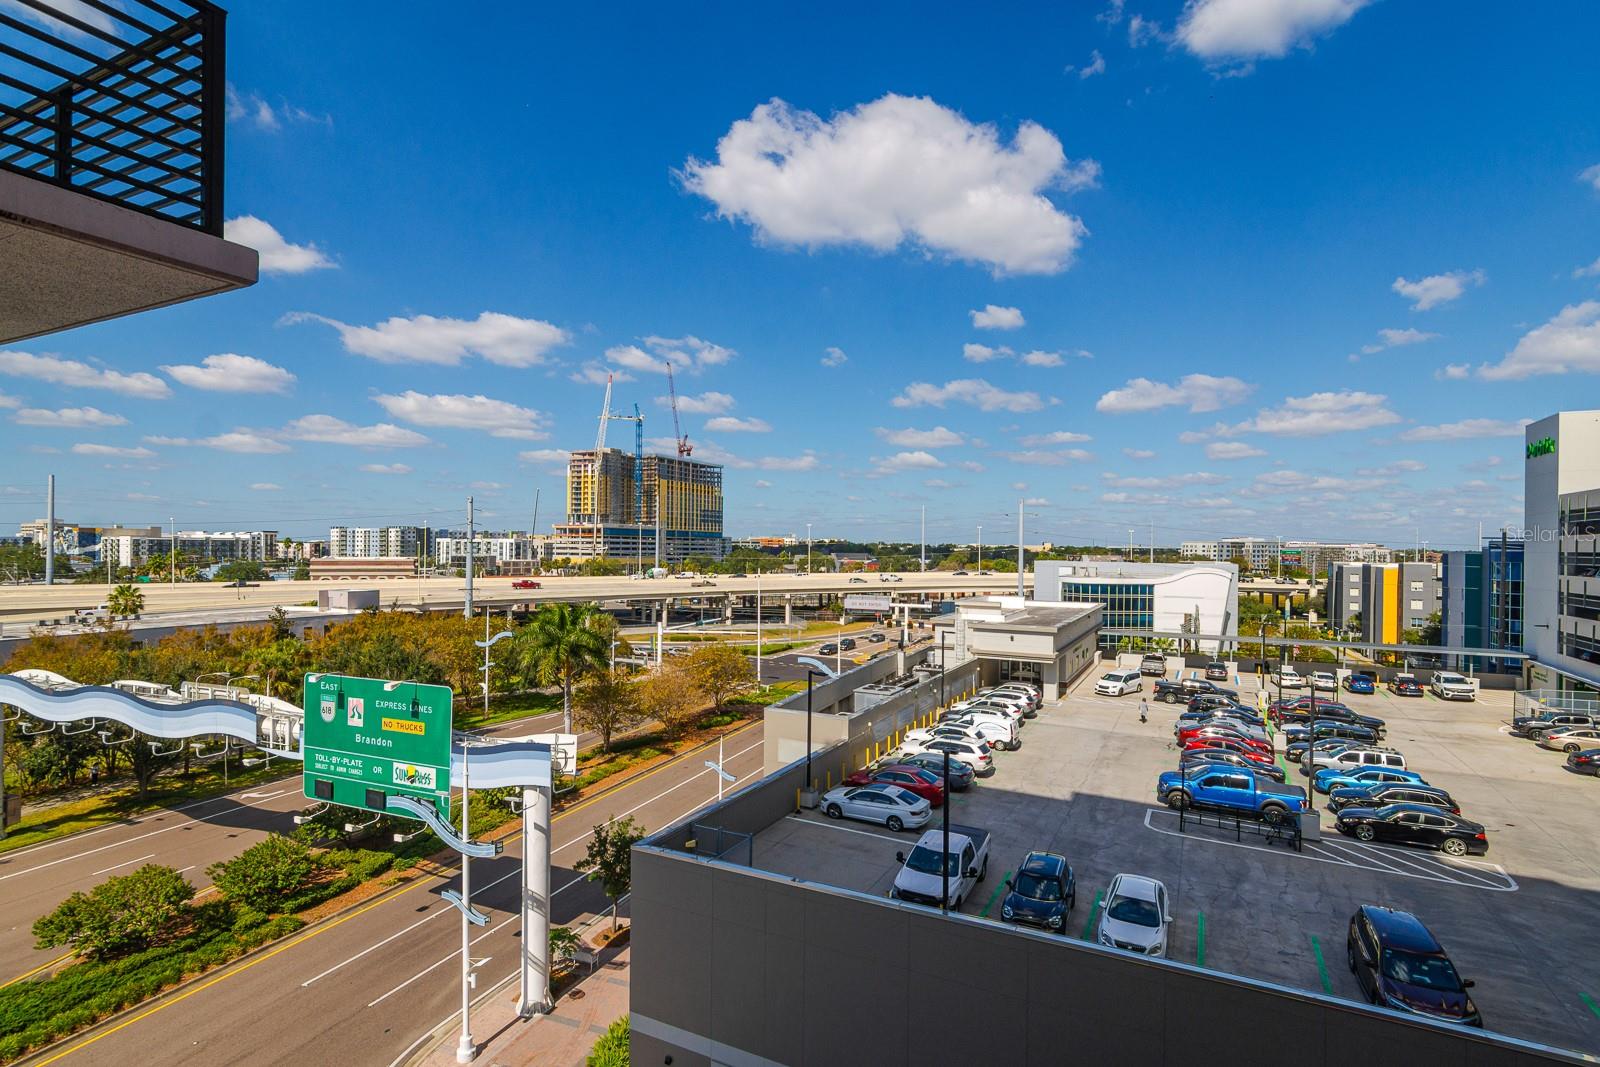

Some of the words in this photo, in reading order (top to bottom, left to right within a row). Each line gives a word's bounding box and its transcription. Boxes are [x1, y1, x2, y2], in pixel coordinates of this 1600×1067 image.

[320, 681, 338, 690] EAST
[322, 706, 332, 715] 618
[375, 700, 407, 711] EXPRESS
[409, 704, 433, 713] LANES
[383, 720, 393, 729] NO
[396, 722, 423, 732] TRUCKS
[355, 733, 393, 748] Brandon
[314, 753, 363, 768] TOLL-BY-PLATE
[372, 765, 383, 775] OR
